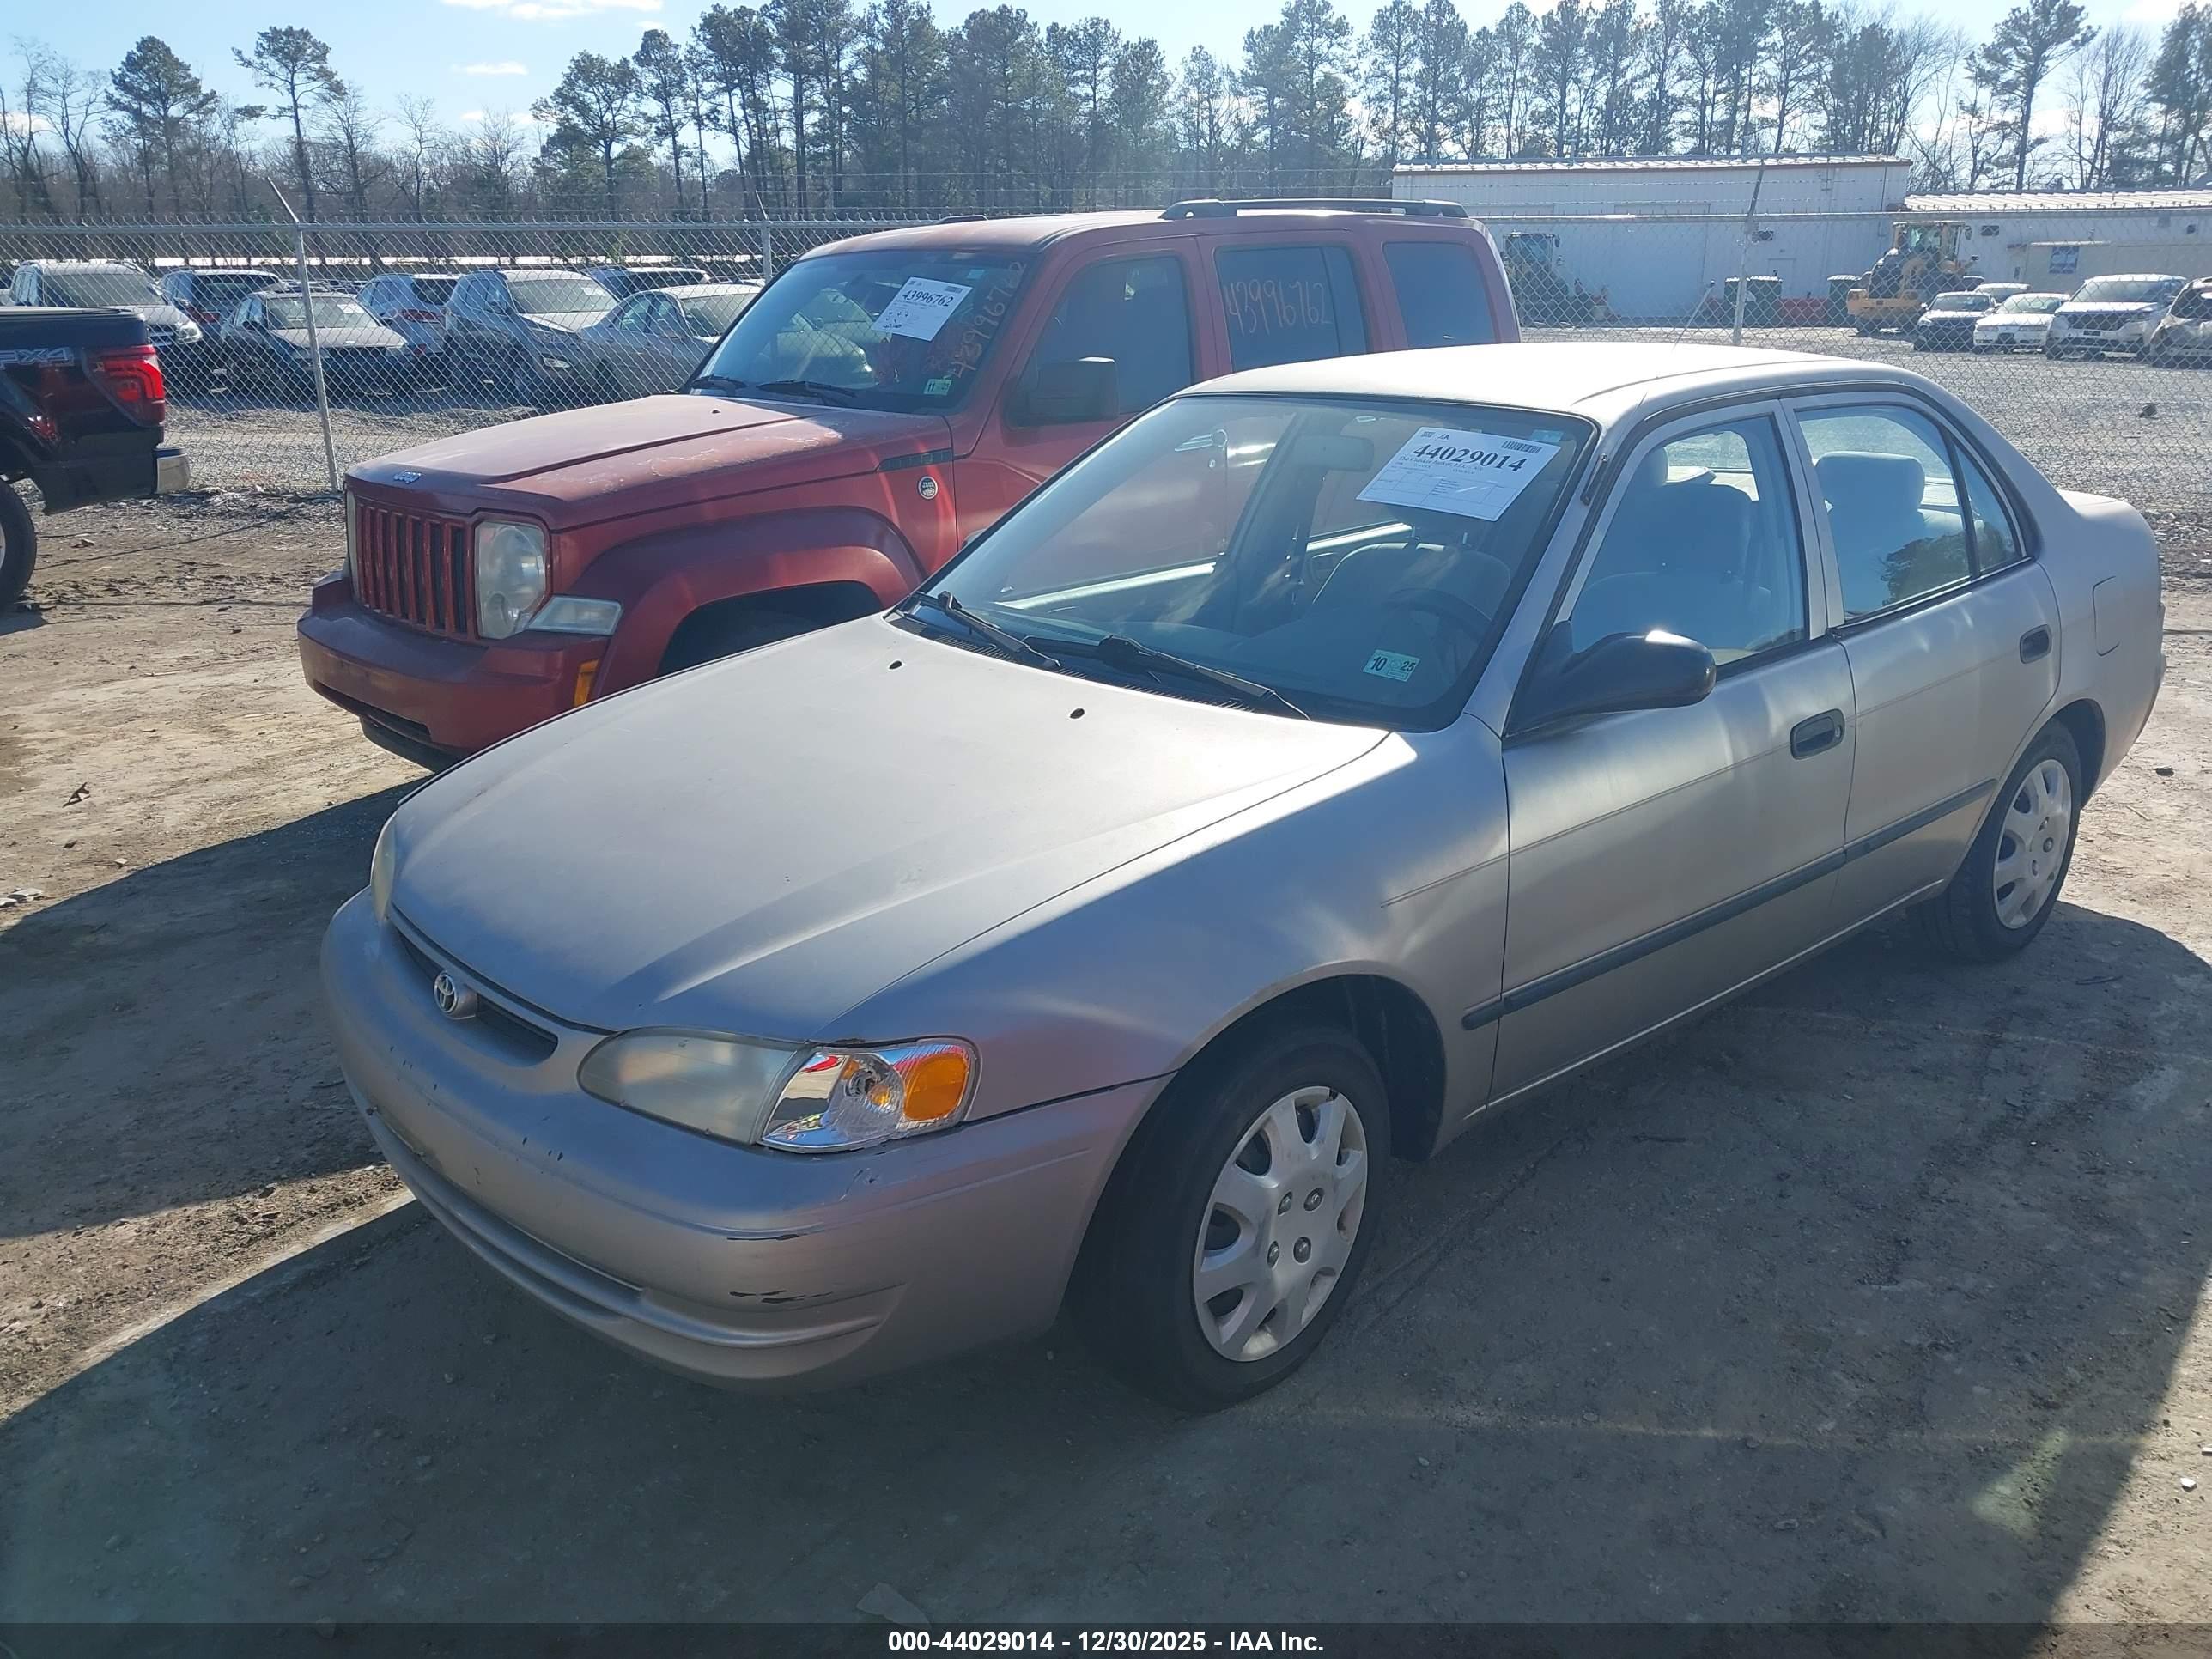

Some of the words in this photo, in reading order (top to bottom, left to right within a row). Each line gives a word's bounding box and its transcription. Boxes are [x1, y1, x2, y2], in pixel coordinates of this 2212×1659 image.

[902, 289, 954, 307] 43996762
[1224, 279, 1333, 336] 43996762
[1413, 444, 1527, 471] 44029014
[1370, 656, 1388, 672] 10
[1400, 660, 1416, 672] 25
